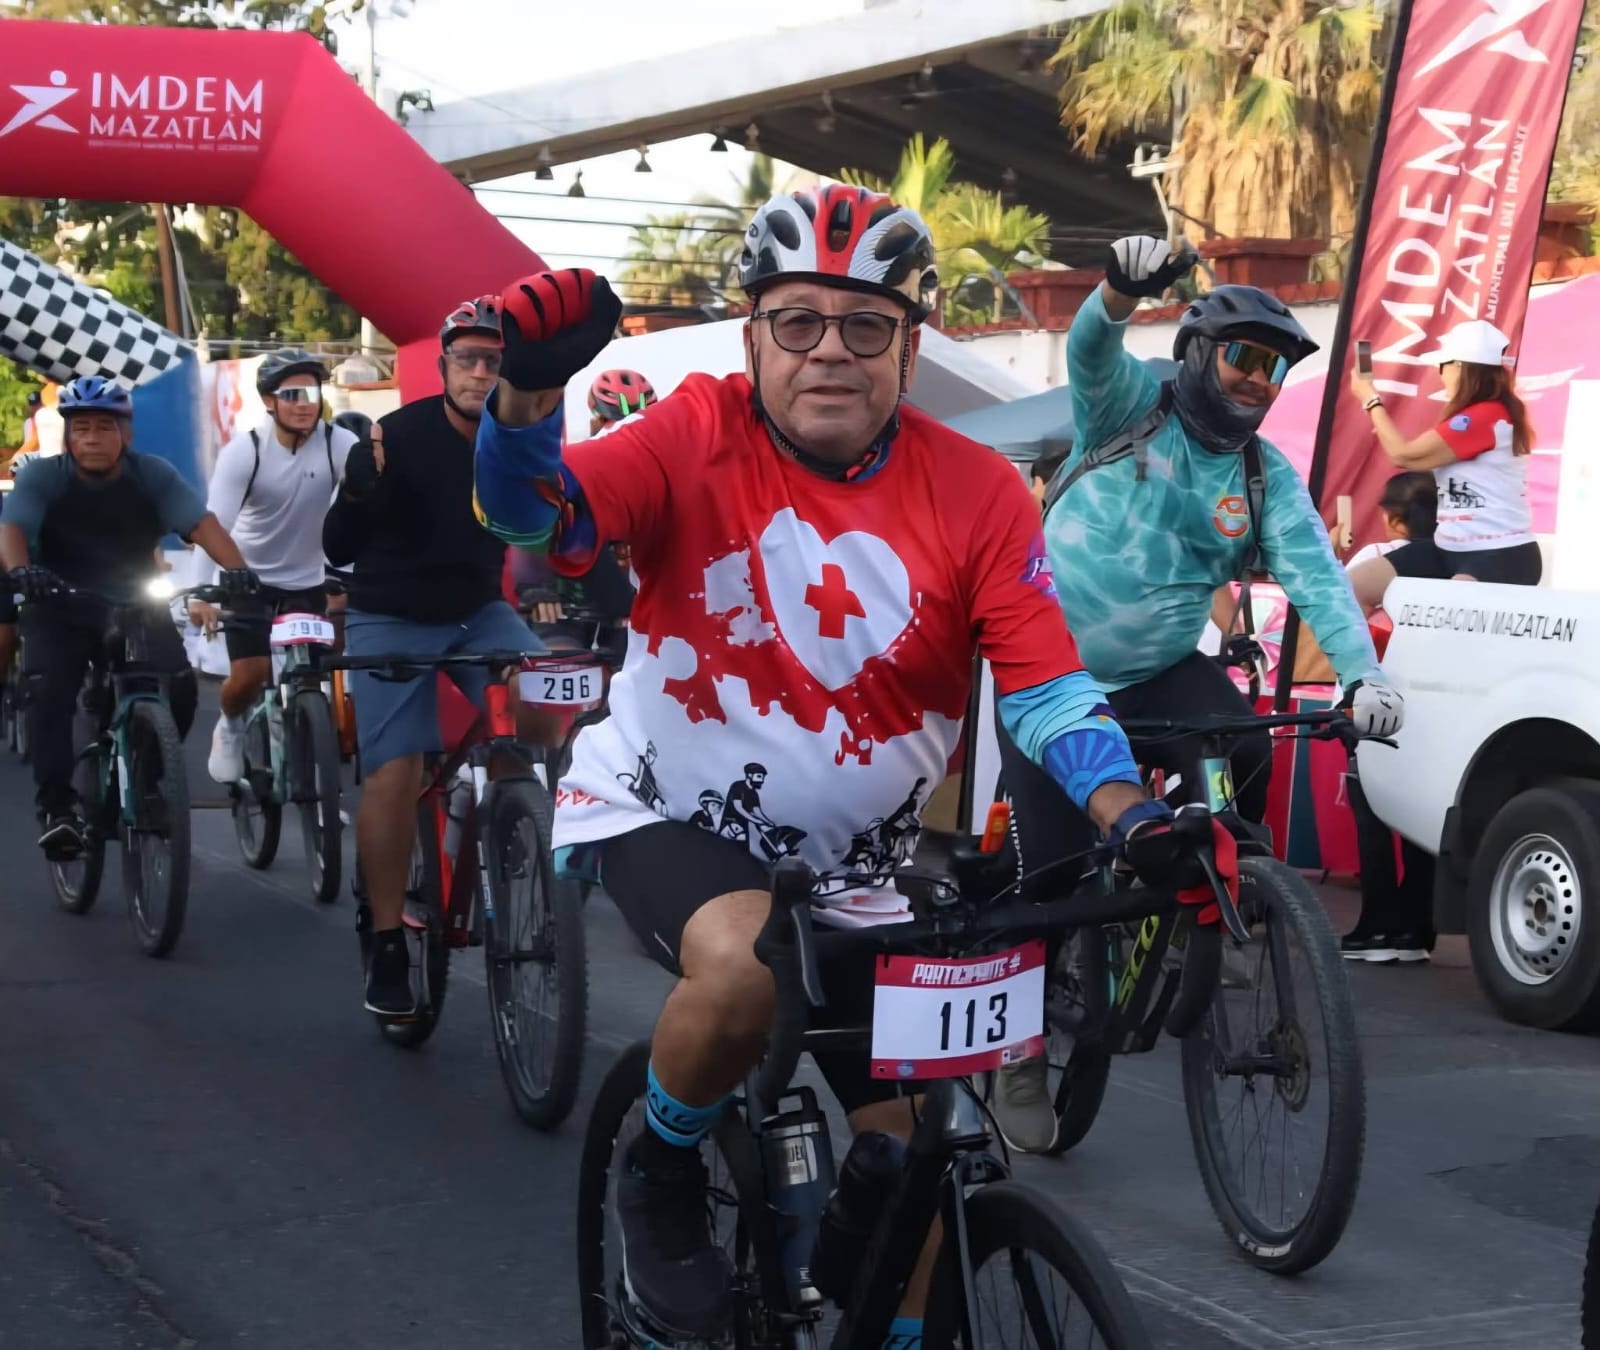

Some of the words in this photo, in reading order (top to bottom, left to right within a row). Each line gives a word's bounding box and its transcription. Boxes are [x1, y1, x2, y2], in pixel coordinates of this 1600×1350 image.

[91, 72, 263, 114] IMDEM
[89, 112, 262, 141] MAZATLÁN
[1371, 107, 1472, 397] IMDEM
[1433, 118, 1511, 400] ZATLÁN
[1399, 604, 1488, 634] DELEGACION
[1490, 611, 1577, 643] MAZATLAN
[544, 675, 590, 701] 296
[940, 992, 1008, 1051] 113
